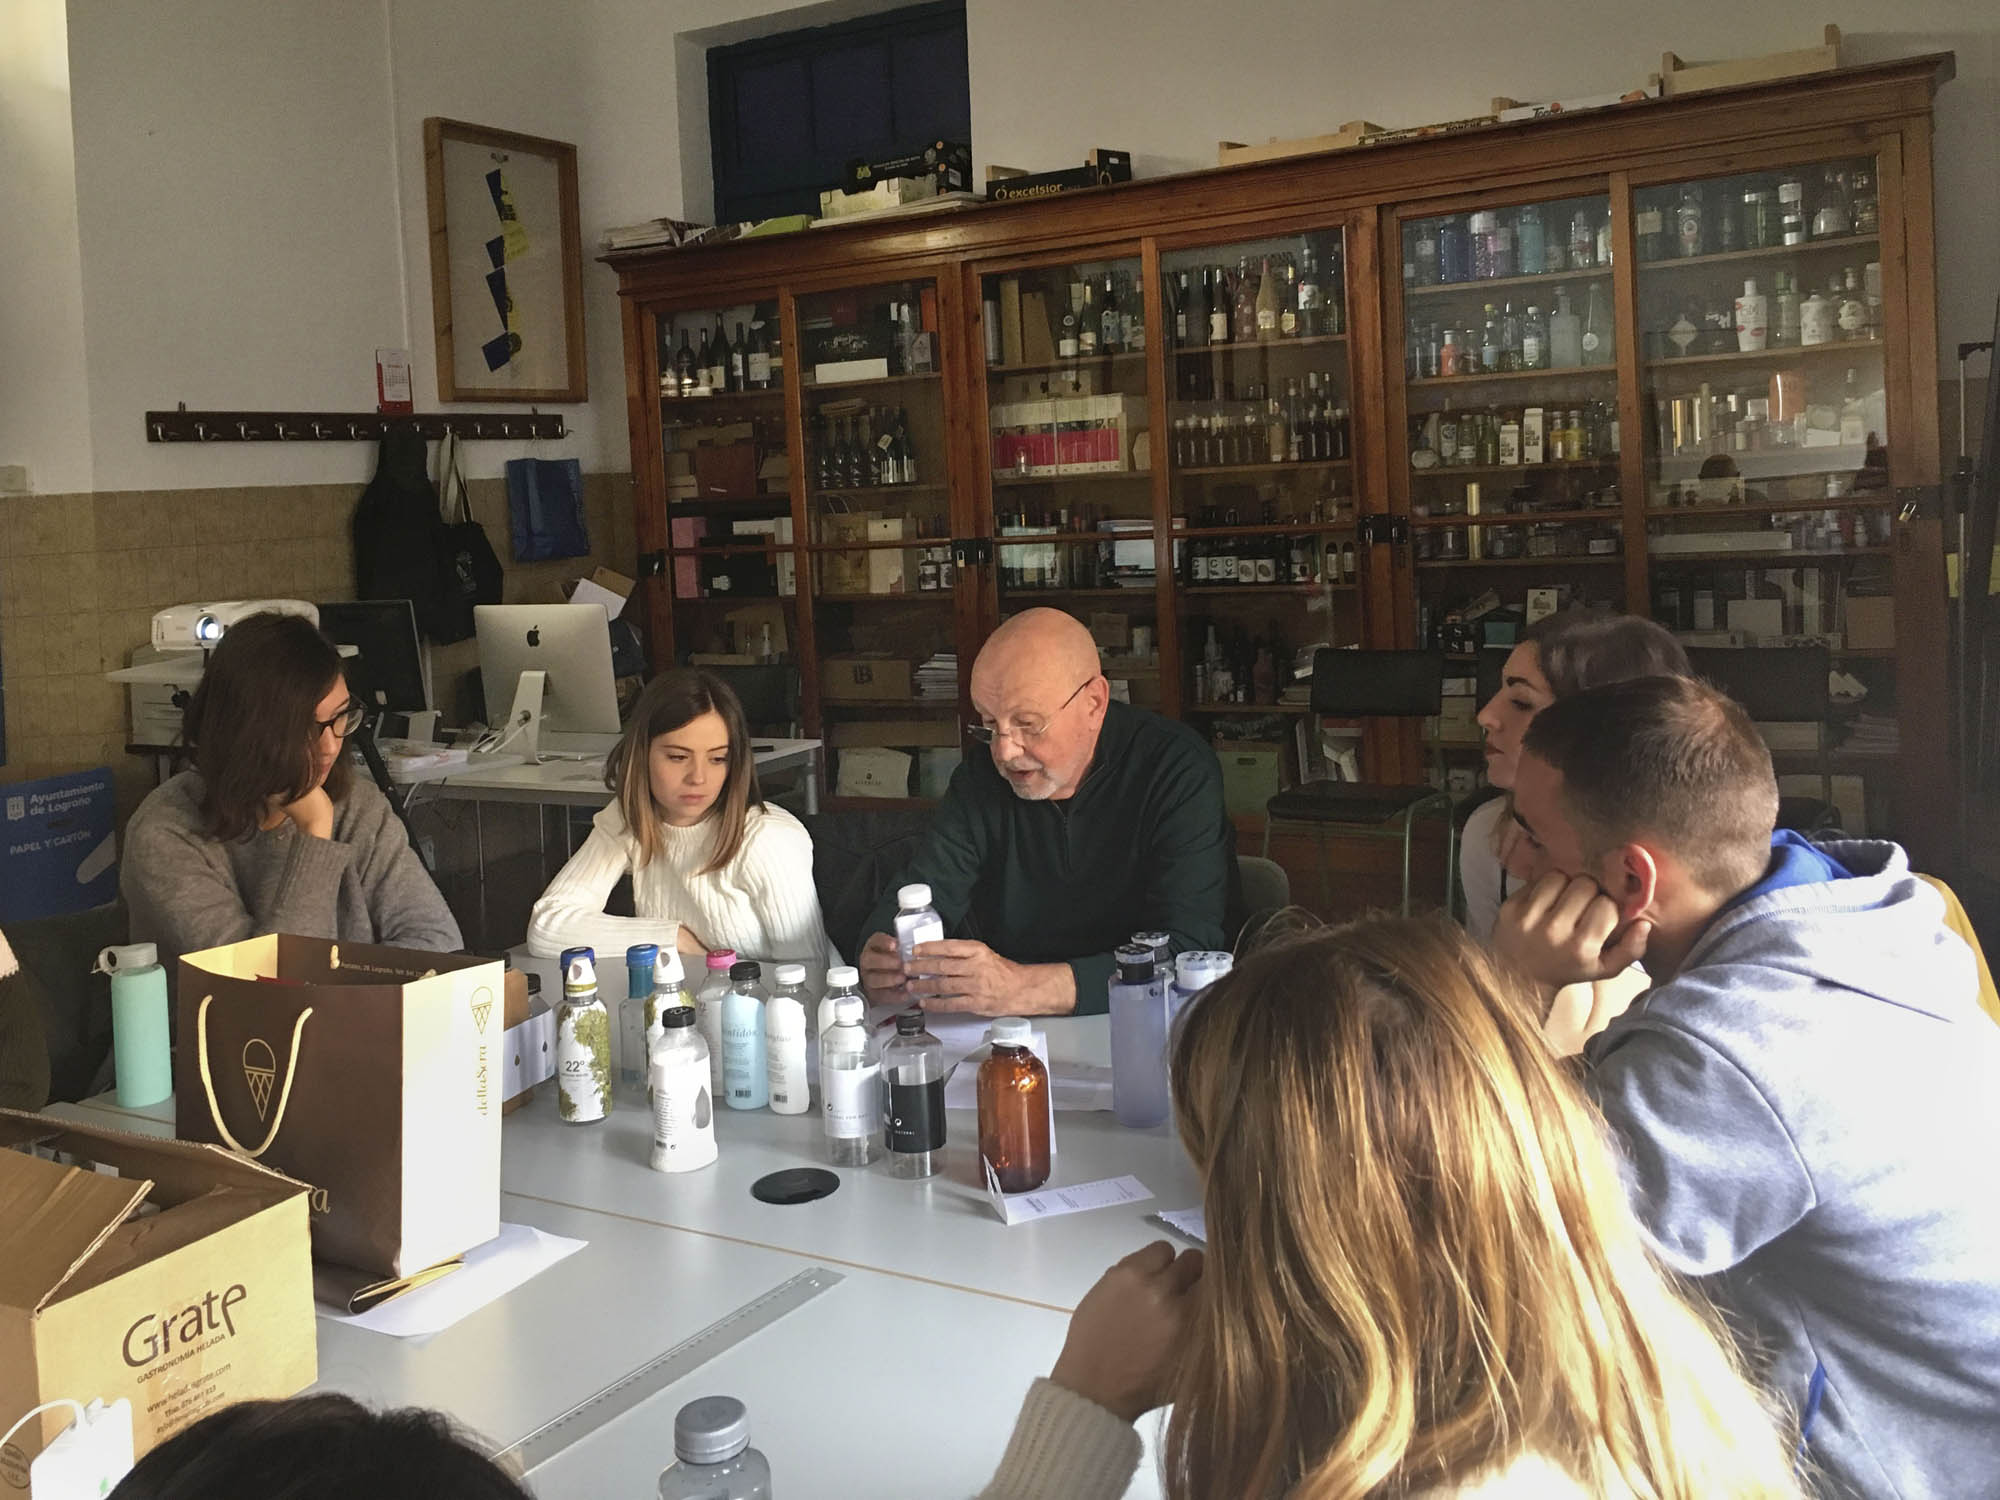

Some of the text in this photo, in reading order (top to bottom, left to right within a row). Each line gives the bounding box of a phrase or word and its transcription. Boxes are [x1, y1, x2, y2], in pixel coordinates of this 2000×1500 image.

[1008, 183, 1062, 199] excelsior
[30, 782, 105, 805] Ayuntamiento
[30, 797, 92, 816] de Logroño
[10, 842, 41, 856] PAPEL
[44, 840, 51, 849] Y
[122, 1284, 247, 1368] Grate
[137, 1333, 226, 1384] GASTRONOMÍA HELADA
